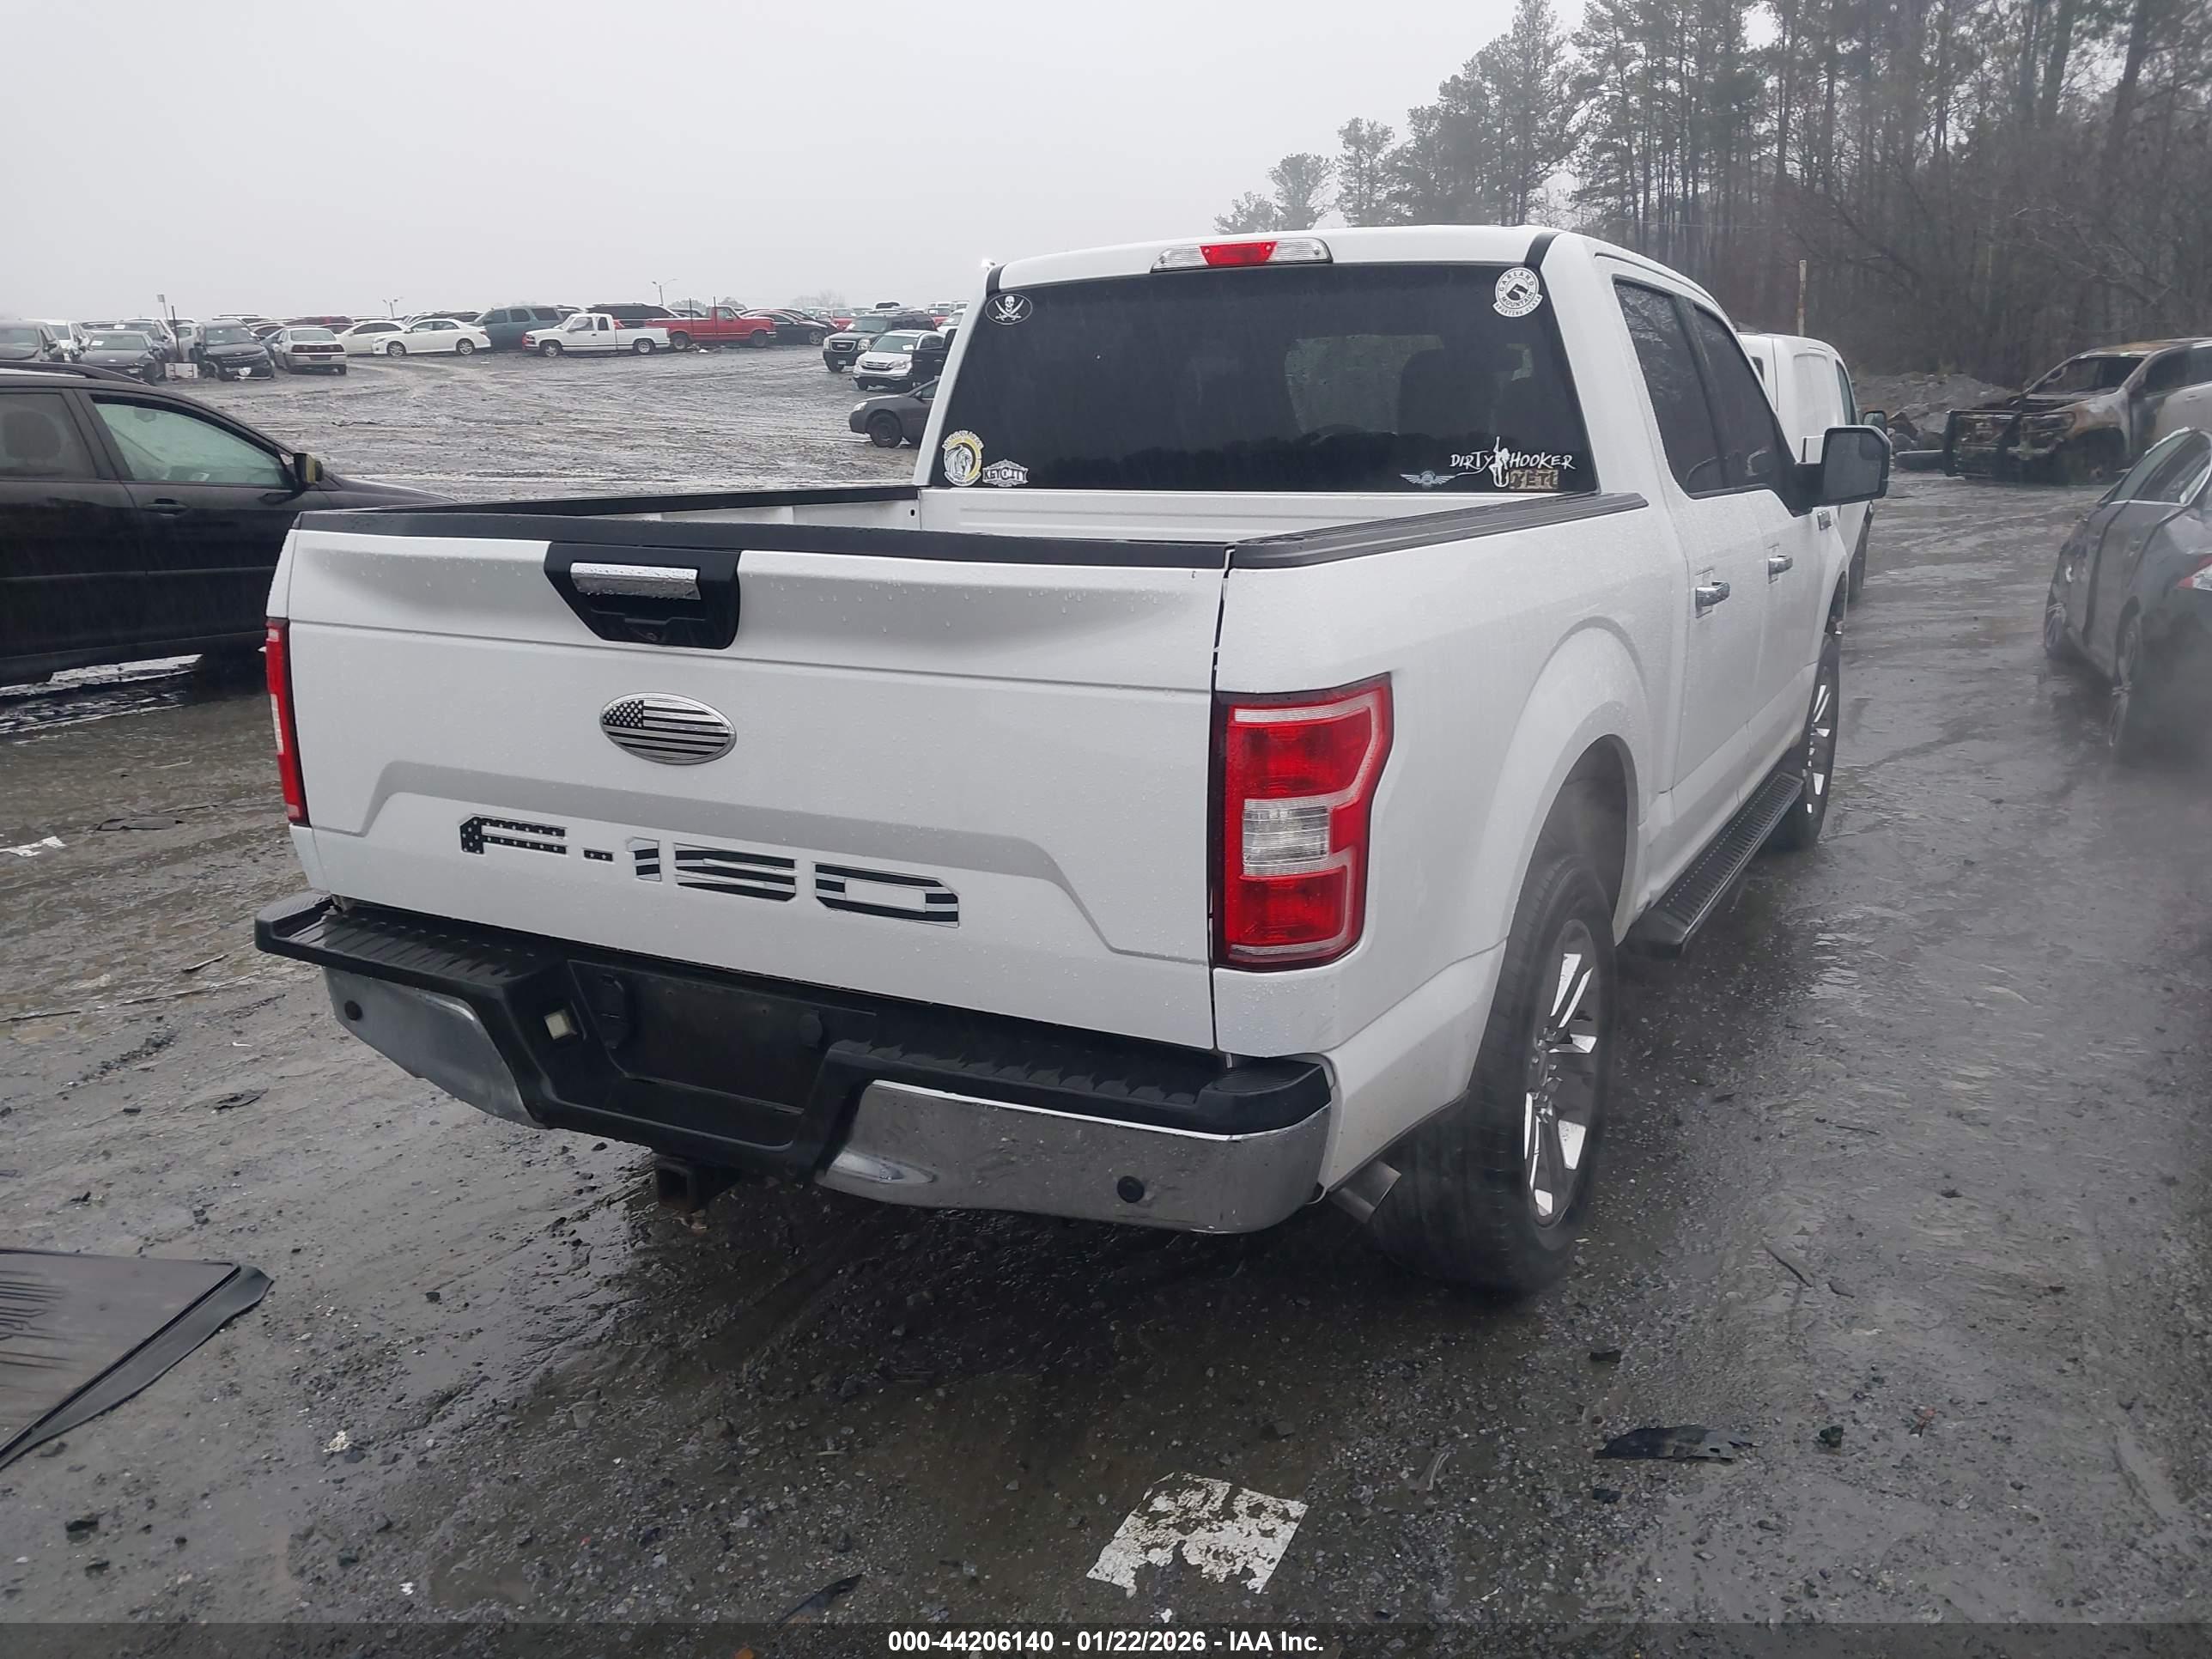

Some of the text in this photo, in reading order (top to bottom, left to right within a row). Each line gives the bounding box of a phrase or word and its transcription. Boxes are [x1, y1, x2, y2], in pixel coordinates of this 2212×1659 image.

[1498, 271, 1534, 292] GARLAND
[1502, 291, 1534, 307] MOUNTAIN
[1449, 450, 1577, 470] DIRTY HOOKER
[459, 813, 959, 928] F-150
